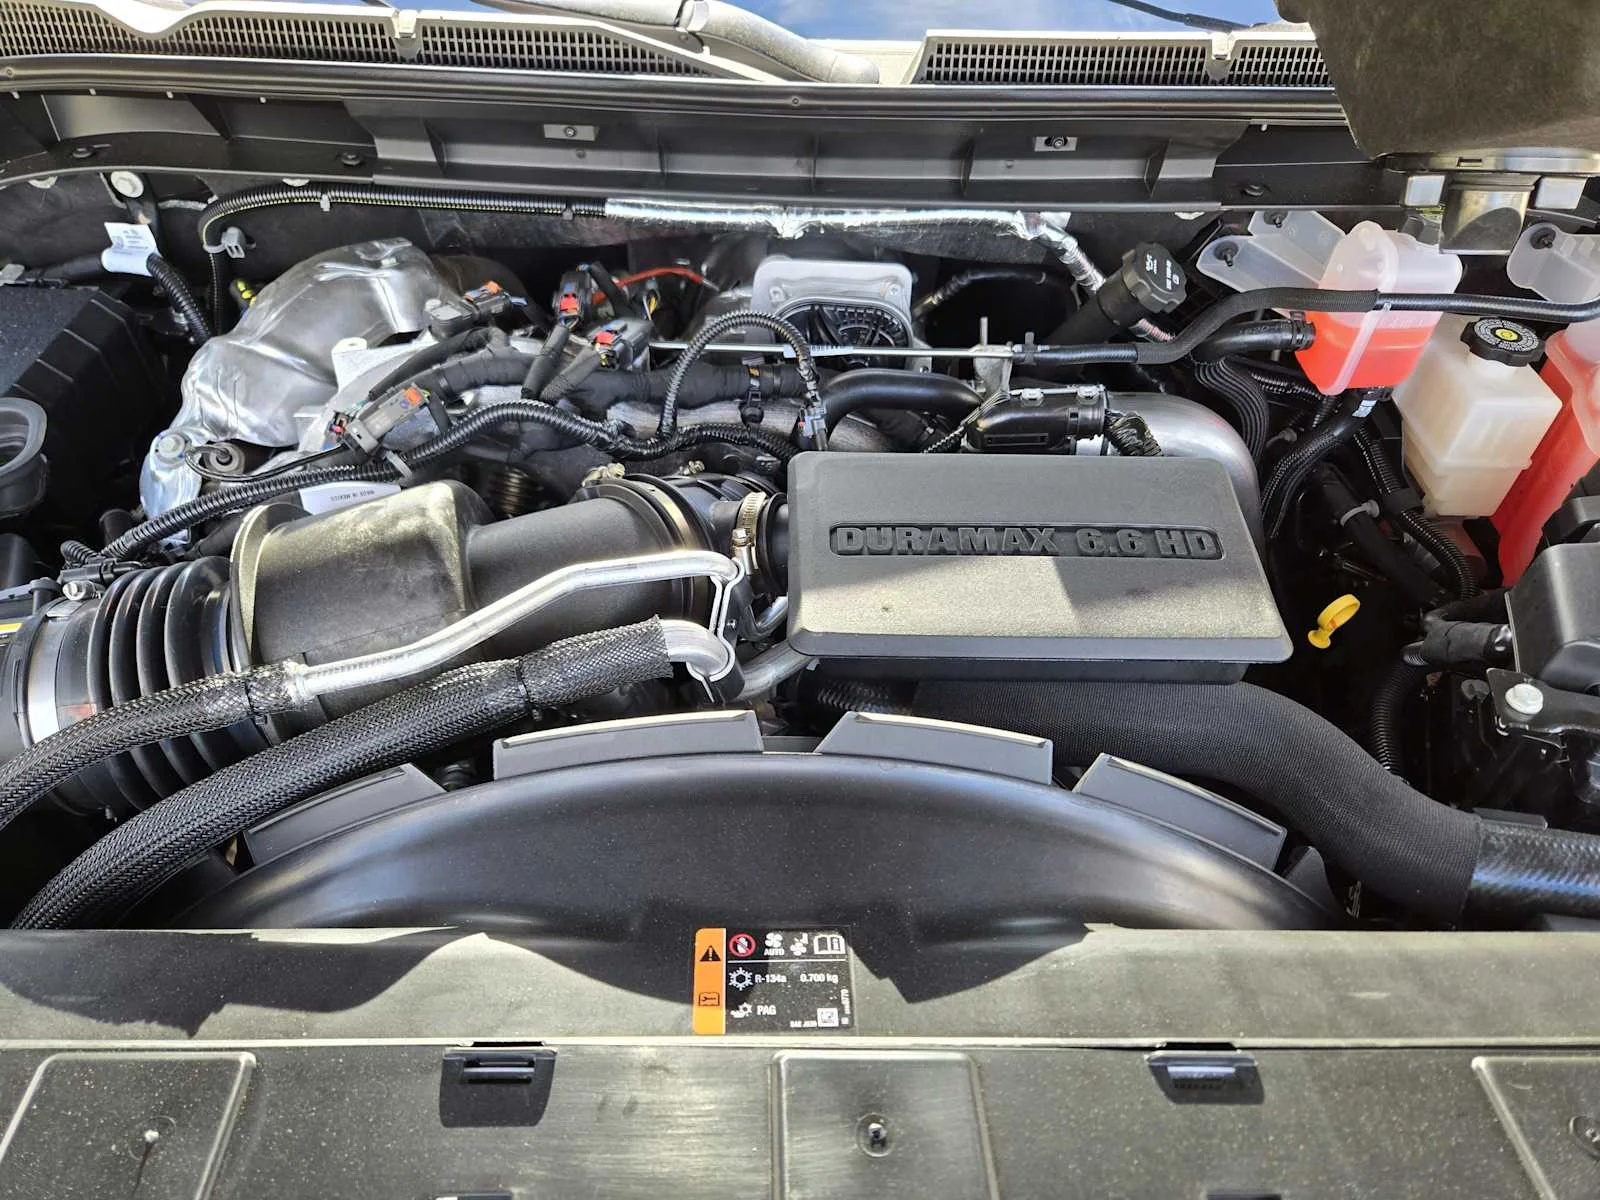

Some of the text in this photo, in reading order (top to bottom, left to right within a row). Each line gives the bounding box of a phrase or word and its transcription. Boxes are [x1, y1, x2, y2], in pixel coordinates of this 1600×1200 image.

[836, 526, 1219, 559] DURAMAX 6.6 HD
[764, 948, 784, 956] AUTO
[754, 973, 838, 984] R-134a 0.700 kg
[756, 1005, 776, 1015] PAG
